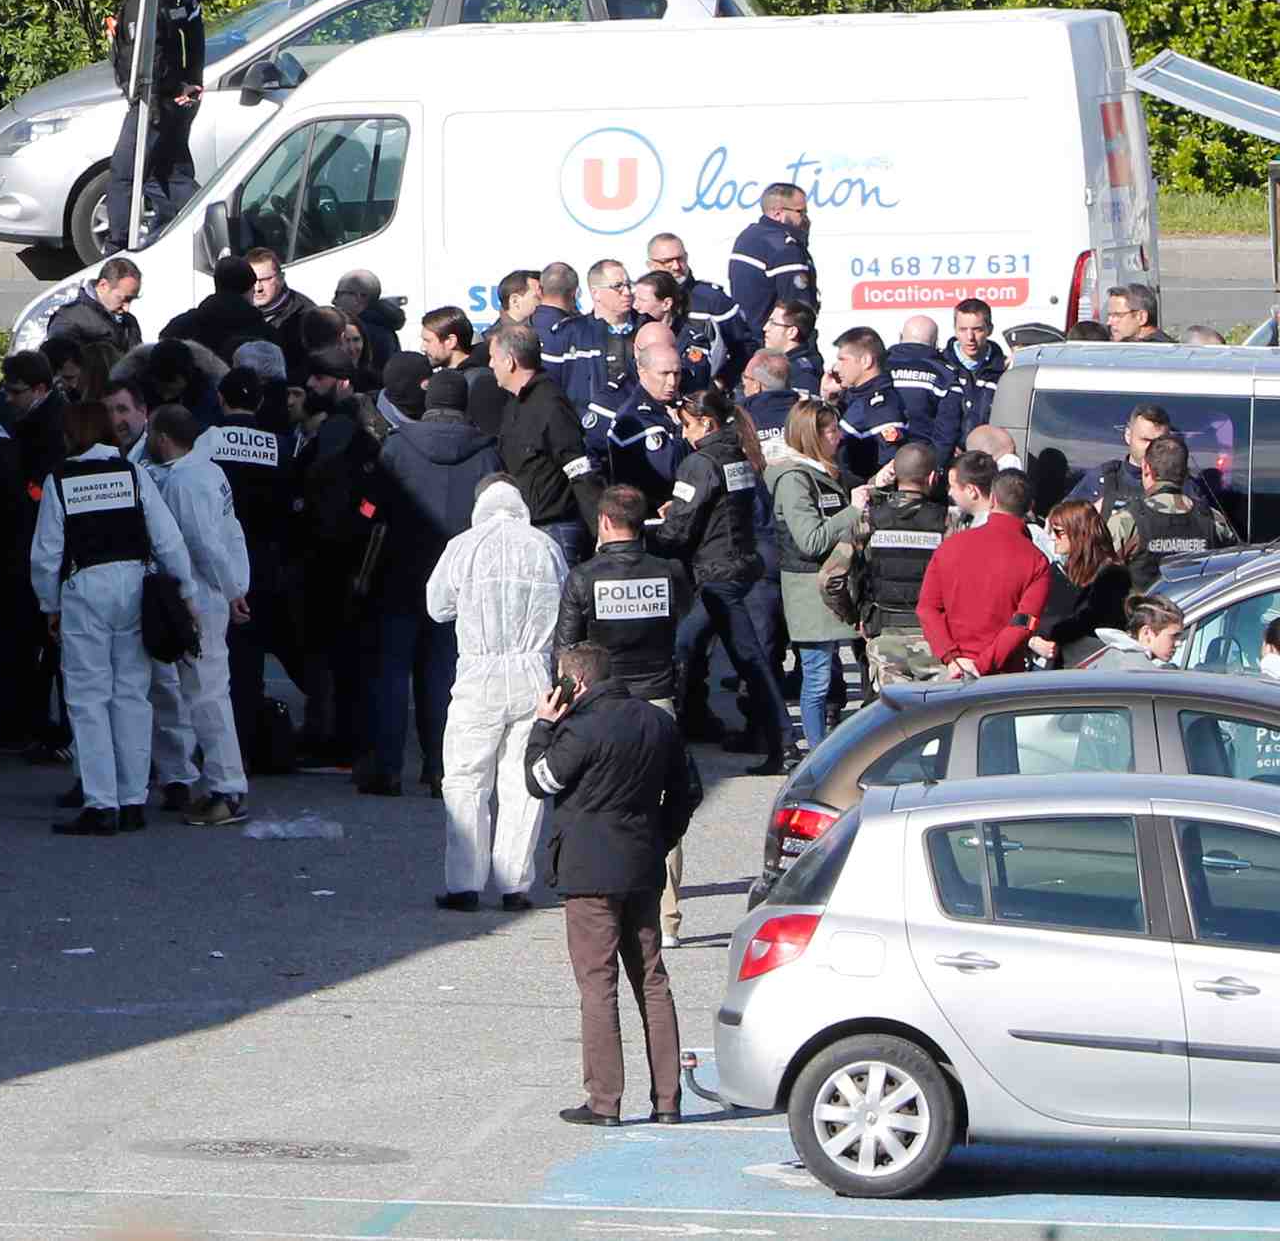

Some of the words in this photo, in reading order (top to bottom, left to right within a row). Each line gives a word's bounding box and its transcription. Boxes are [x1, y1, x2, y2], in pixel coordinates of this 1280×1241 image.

[584, 157, 638, 210] U
[682, 146, 900, 212] loction
[850, 257, 881, 277] 04
[890, 256, 921, 276] 68
[931, 255, 976, 275] 787
[987, 254, 1031, 274] 631
[1148, 538, 1207, 552] GENDARMERIE
[598, 583, 667, 600] POLICE
[599, 602, 668, 614] JUDICIAIRE
